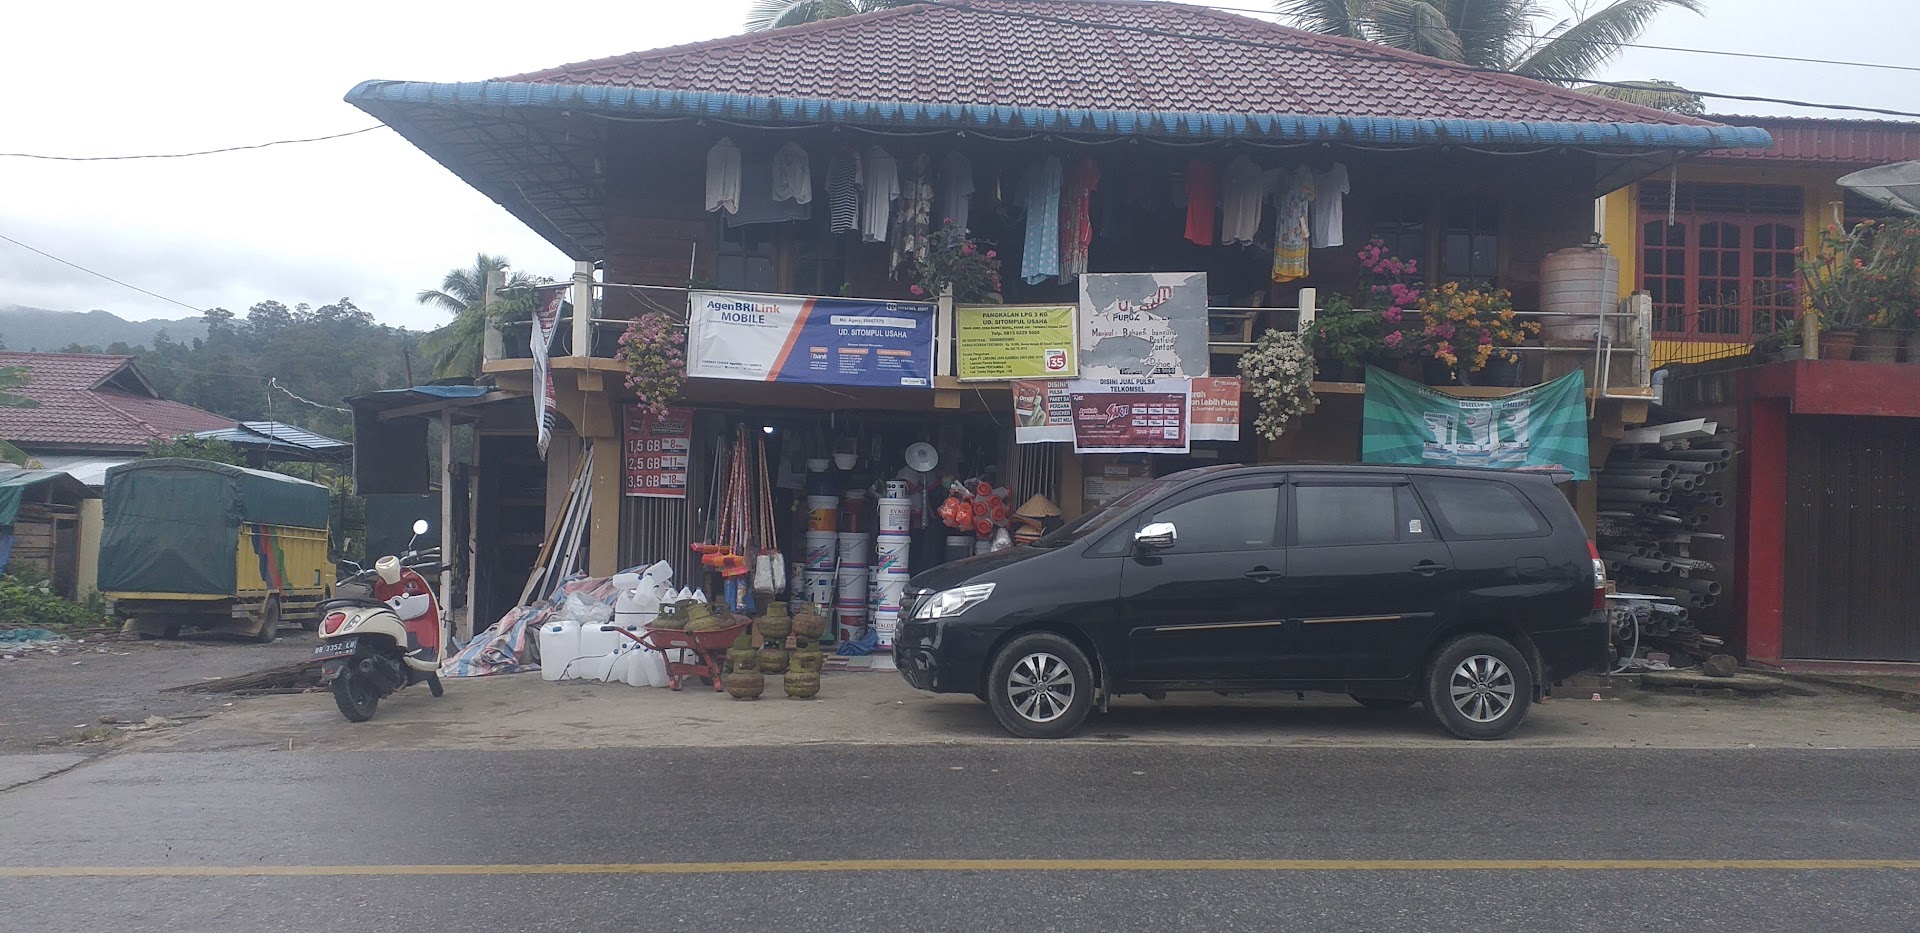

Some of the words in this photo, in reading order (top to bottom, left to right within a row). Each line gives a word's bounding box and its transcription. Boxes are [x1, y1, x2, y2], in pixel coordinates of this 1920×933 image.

[707, 300, 780, 313] AgenBRILink
[721, 312, 765, 324] MOBILE
[838, 328, 849, 336] UD.
[851, 329, 883, 337] SITOMPUL
[1502, 400, 1530, 410] PHILIPS
[1424, 412, 1447, 420] PHILIPS
[651, 422, 686, 430] VOUCHER
[629, 440, 643, 453] 1,5
[646, 440, 660, 452] GB
[670, 440, 676, 448] 8
[629, 457, 643, 470] 2,5
[646, 457, 660, 469] GB
[669, 457, 677, 466] 11
[628, 475, 643, 489] 3,5
[646, 475, 660, 487] GB
[668, 475, 676, 483] 18
[325, 643, 342, 652] 3352
